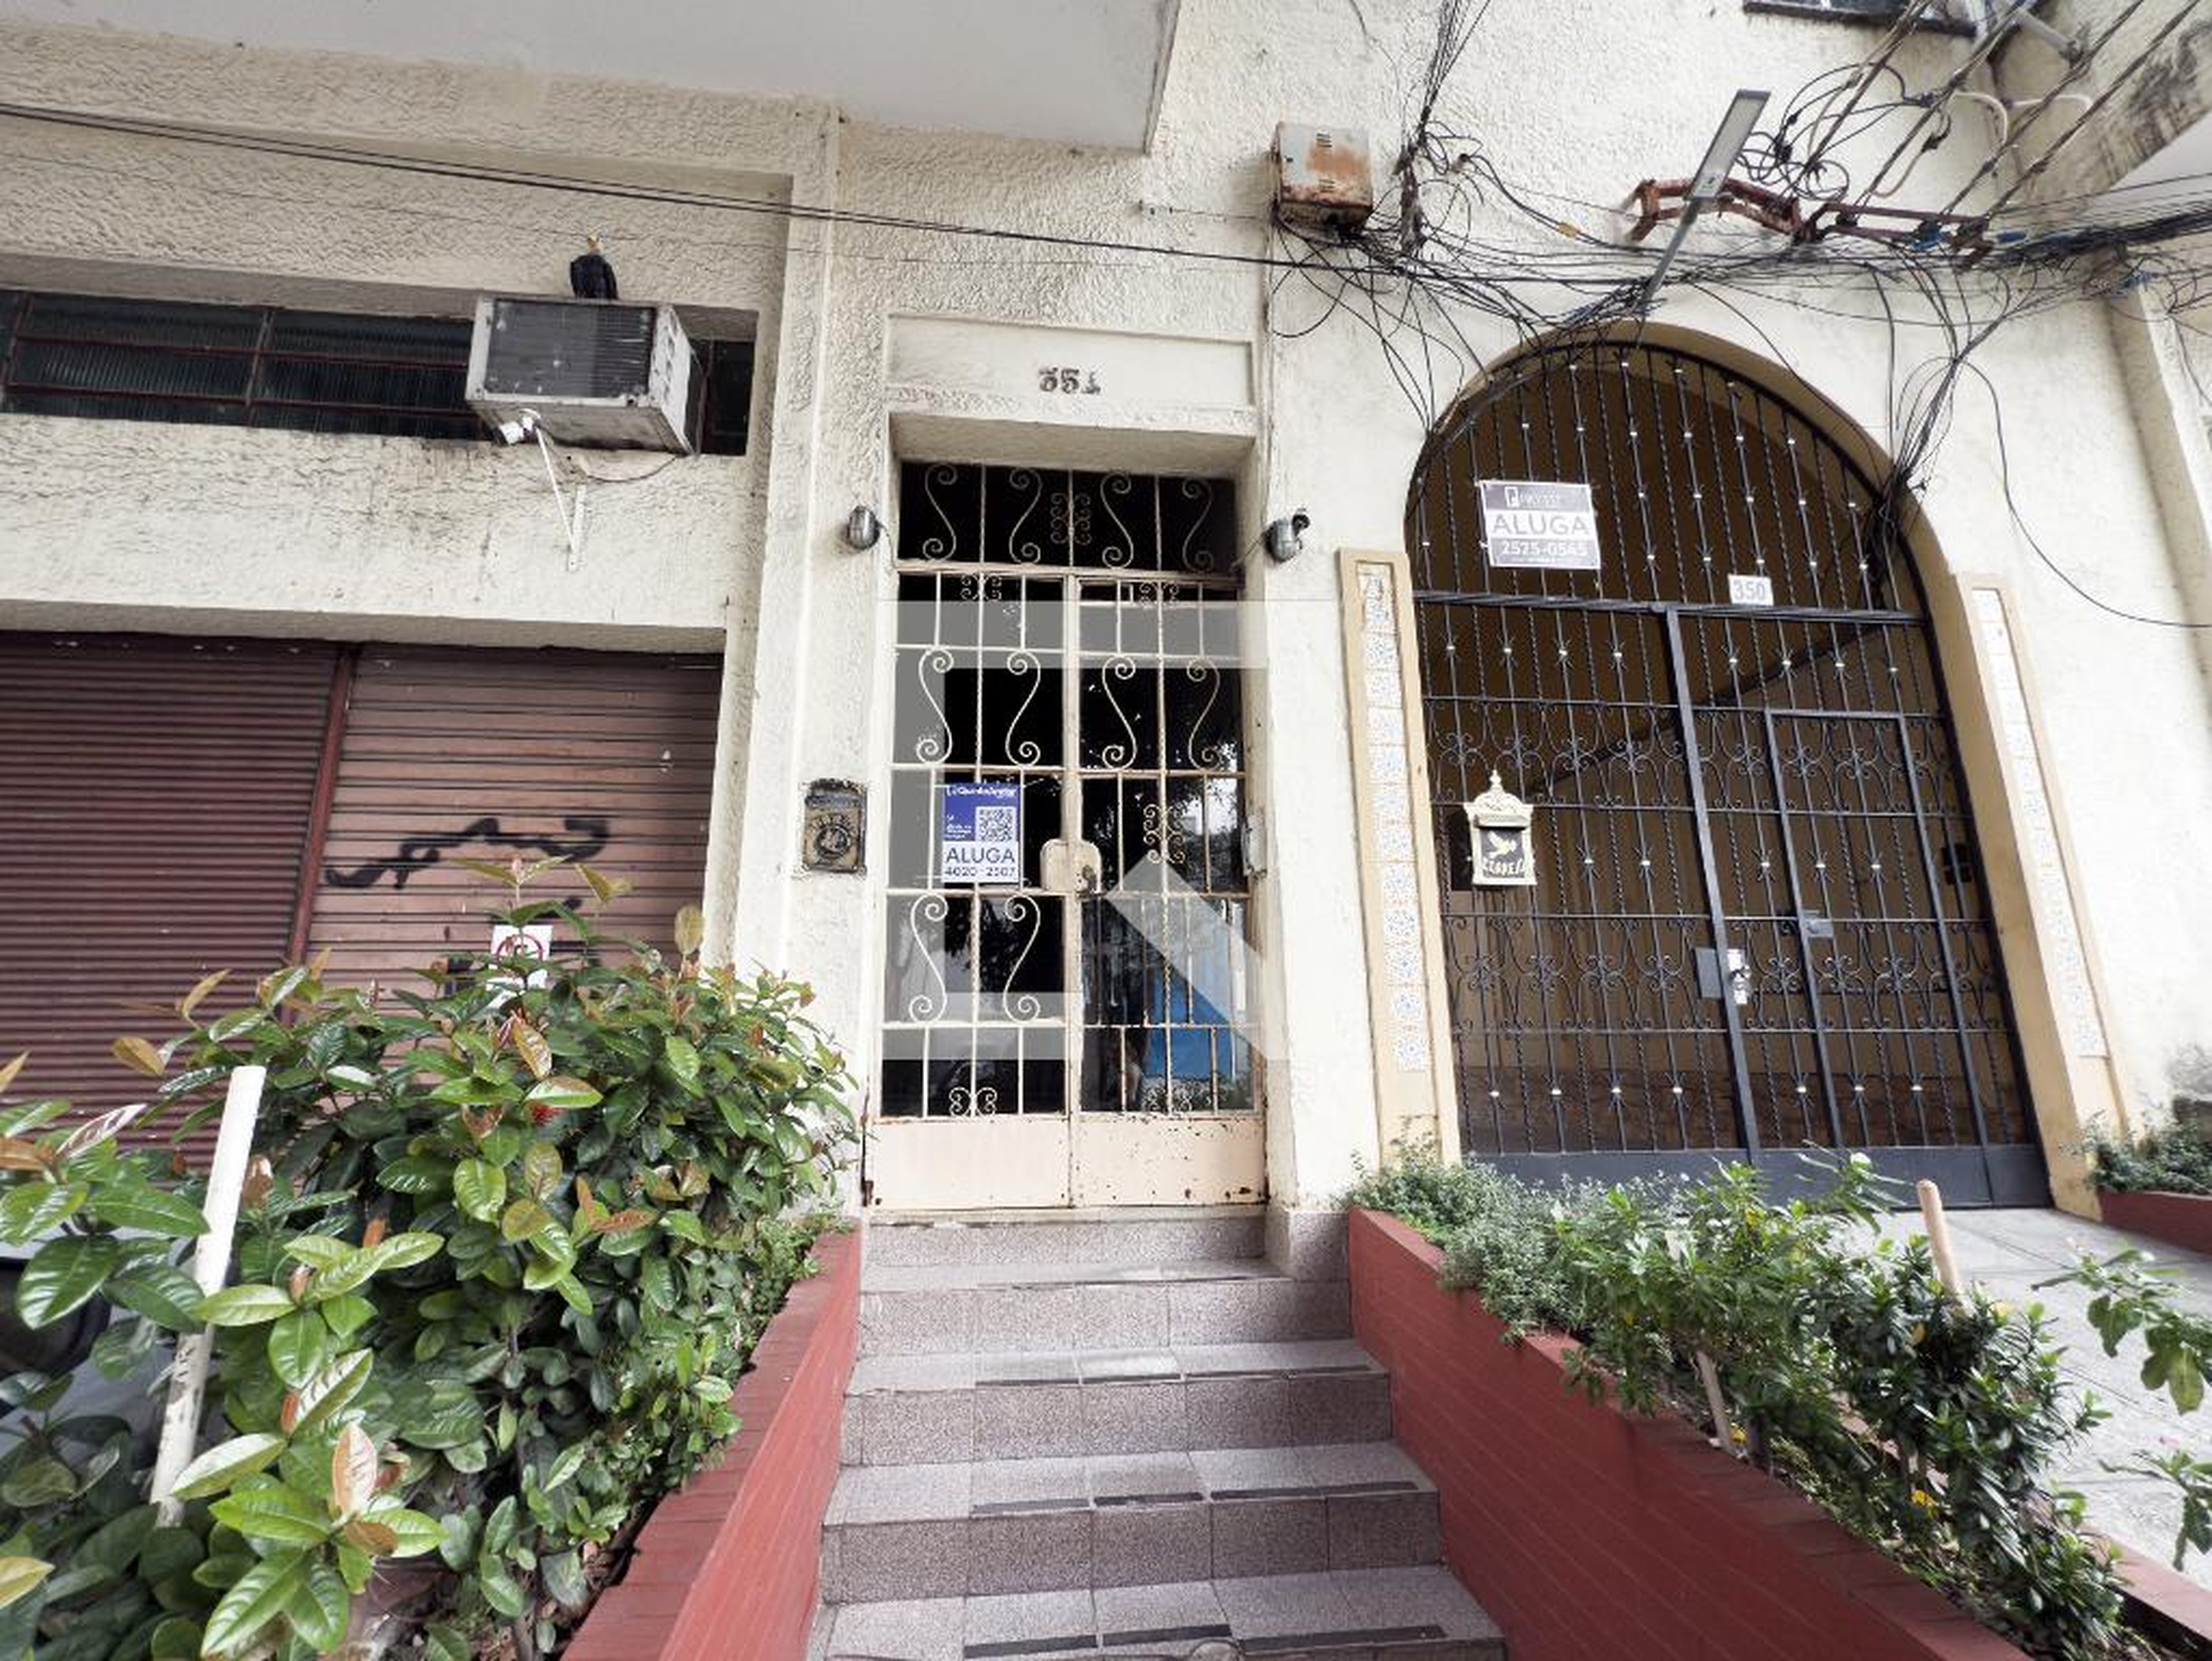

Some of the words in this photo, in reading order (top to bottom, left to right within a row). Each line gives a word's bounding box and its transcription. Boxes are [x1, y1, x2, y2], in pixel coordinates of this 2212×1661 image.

[1493, 513, 1590, 535] ALUGA
[1733, 580, 1765, 600] 350
[946, 847, 1016, 864] ALUGA
